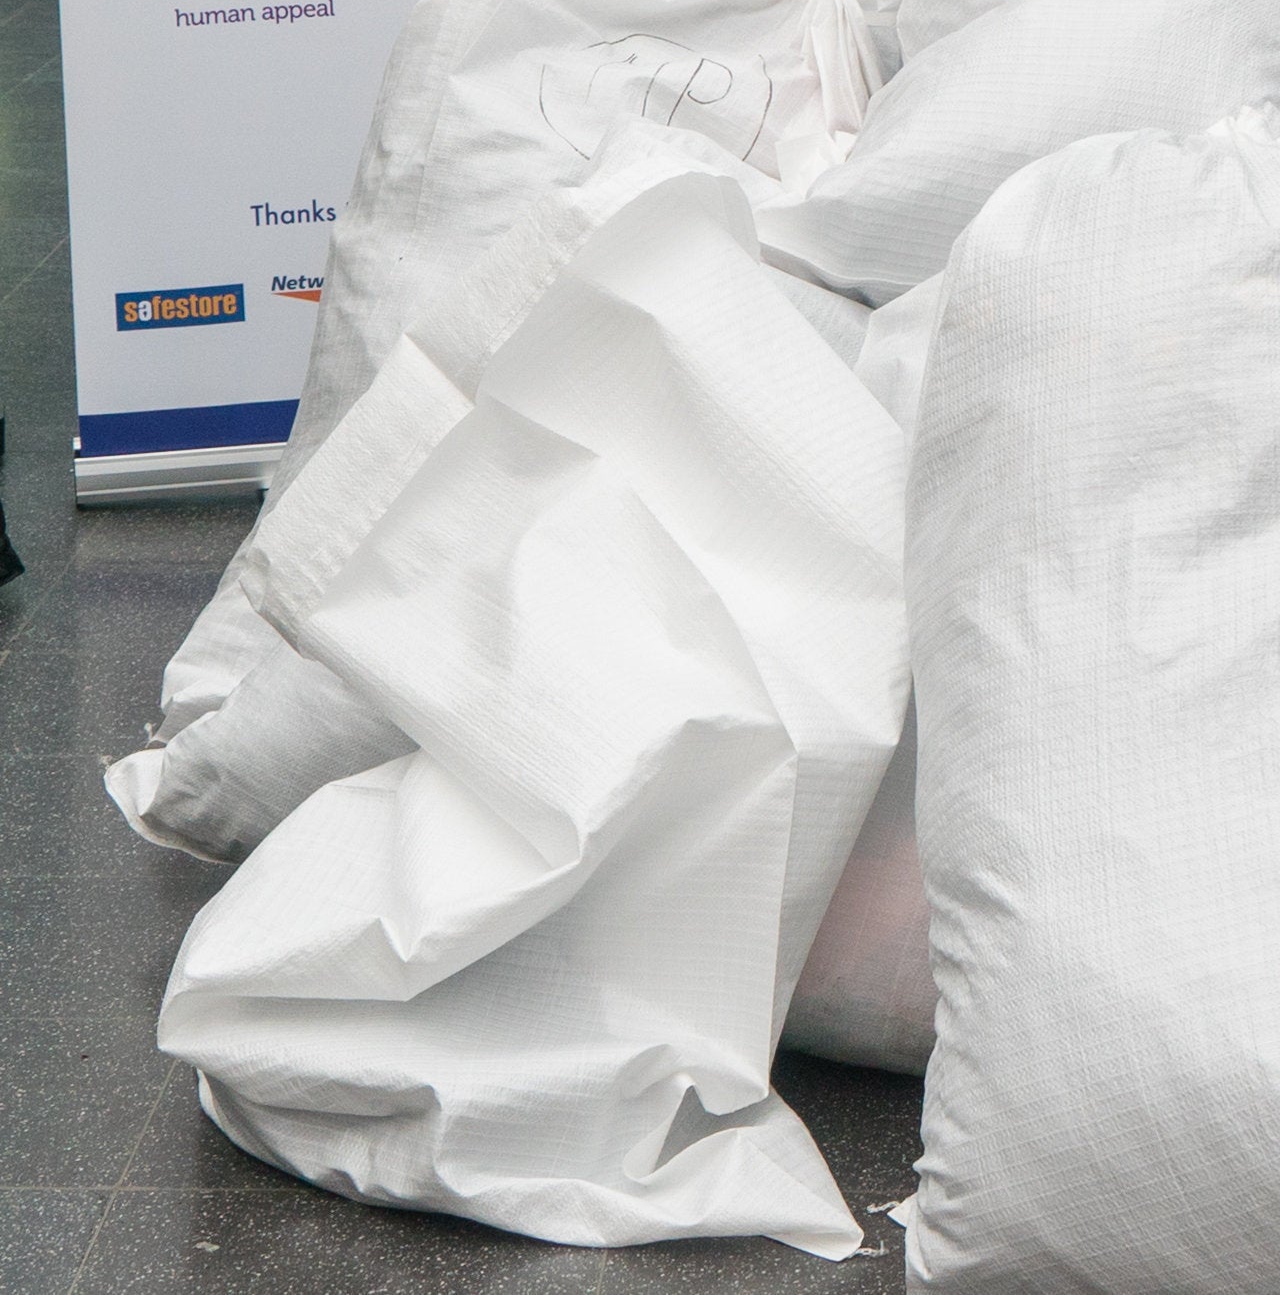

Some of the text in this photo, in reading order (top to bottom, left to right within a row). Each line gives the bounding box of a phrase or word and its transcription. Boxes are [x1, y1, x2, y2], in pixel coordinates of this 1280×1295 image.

[175, 8, 256, 27] human
[250, 199, 336, 226] Thanks
[124, 274, 324, 322] safestore Netw
